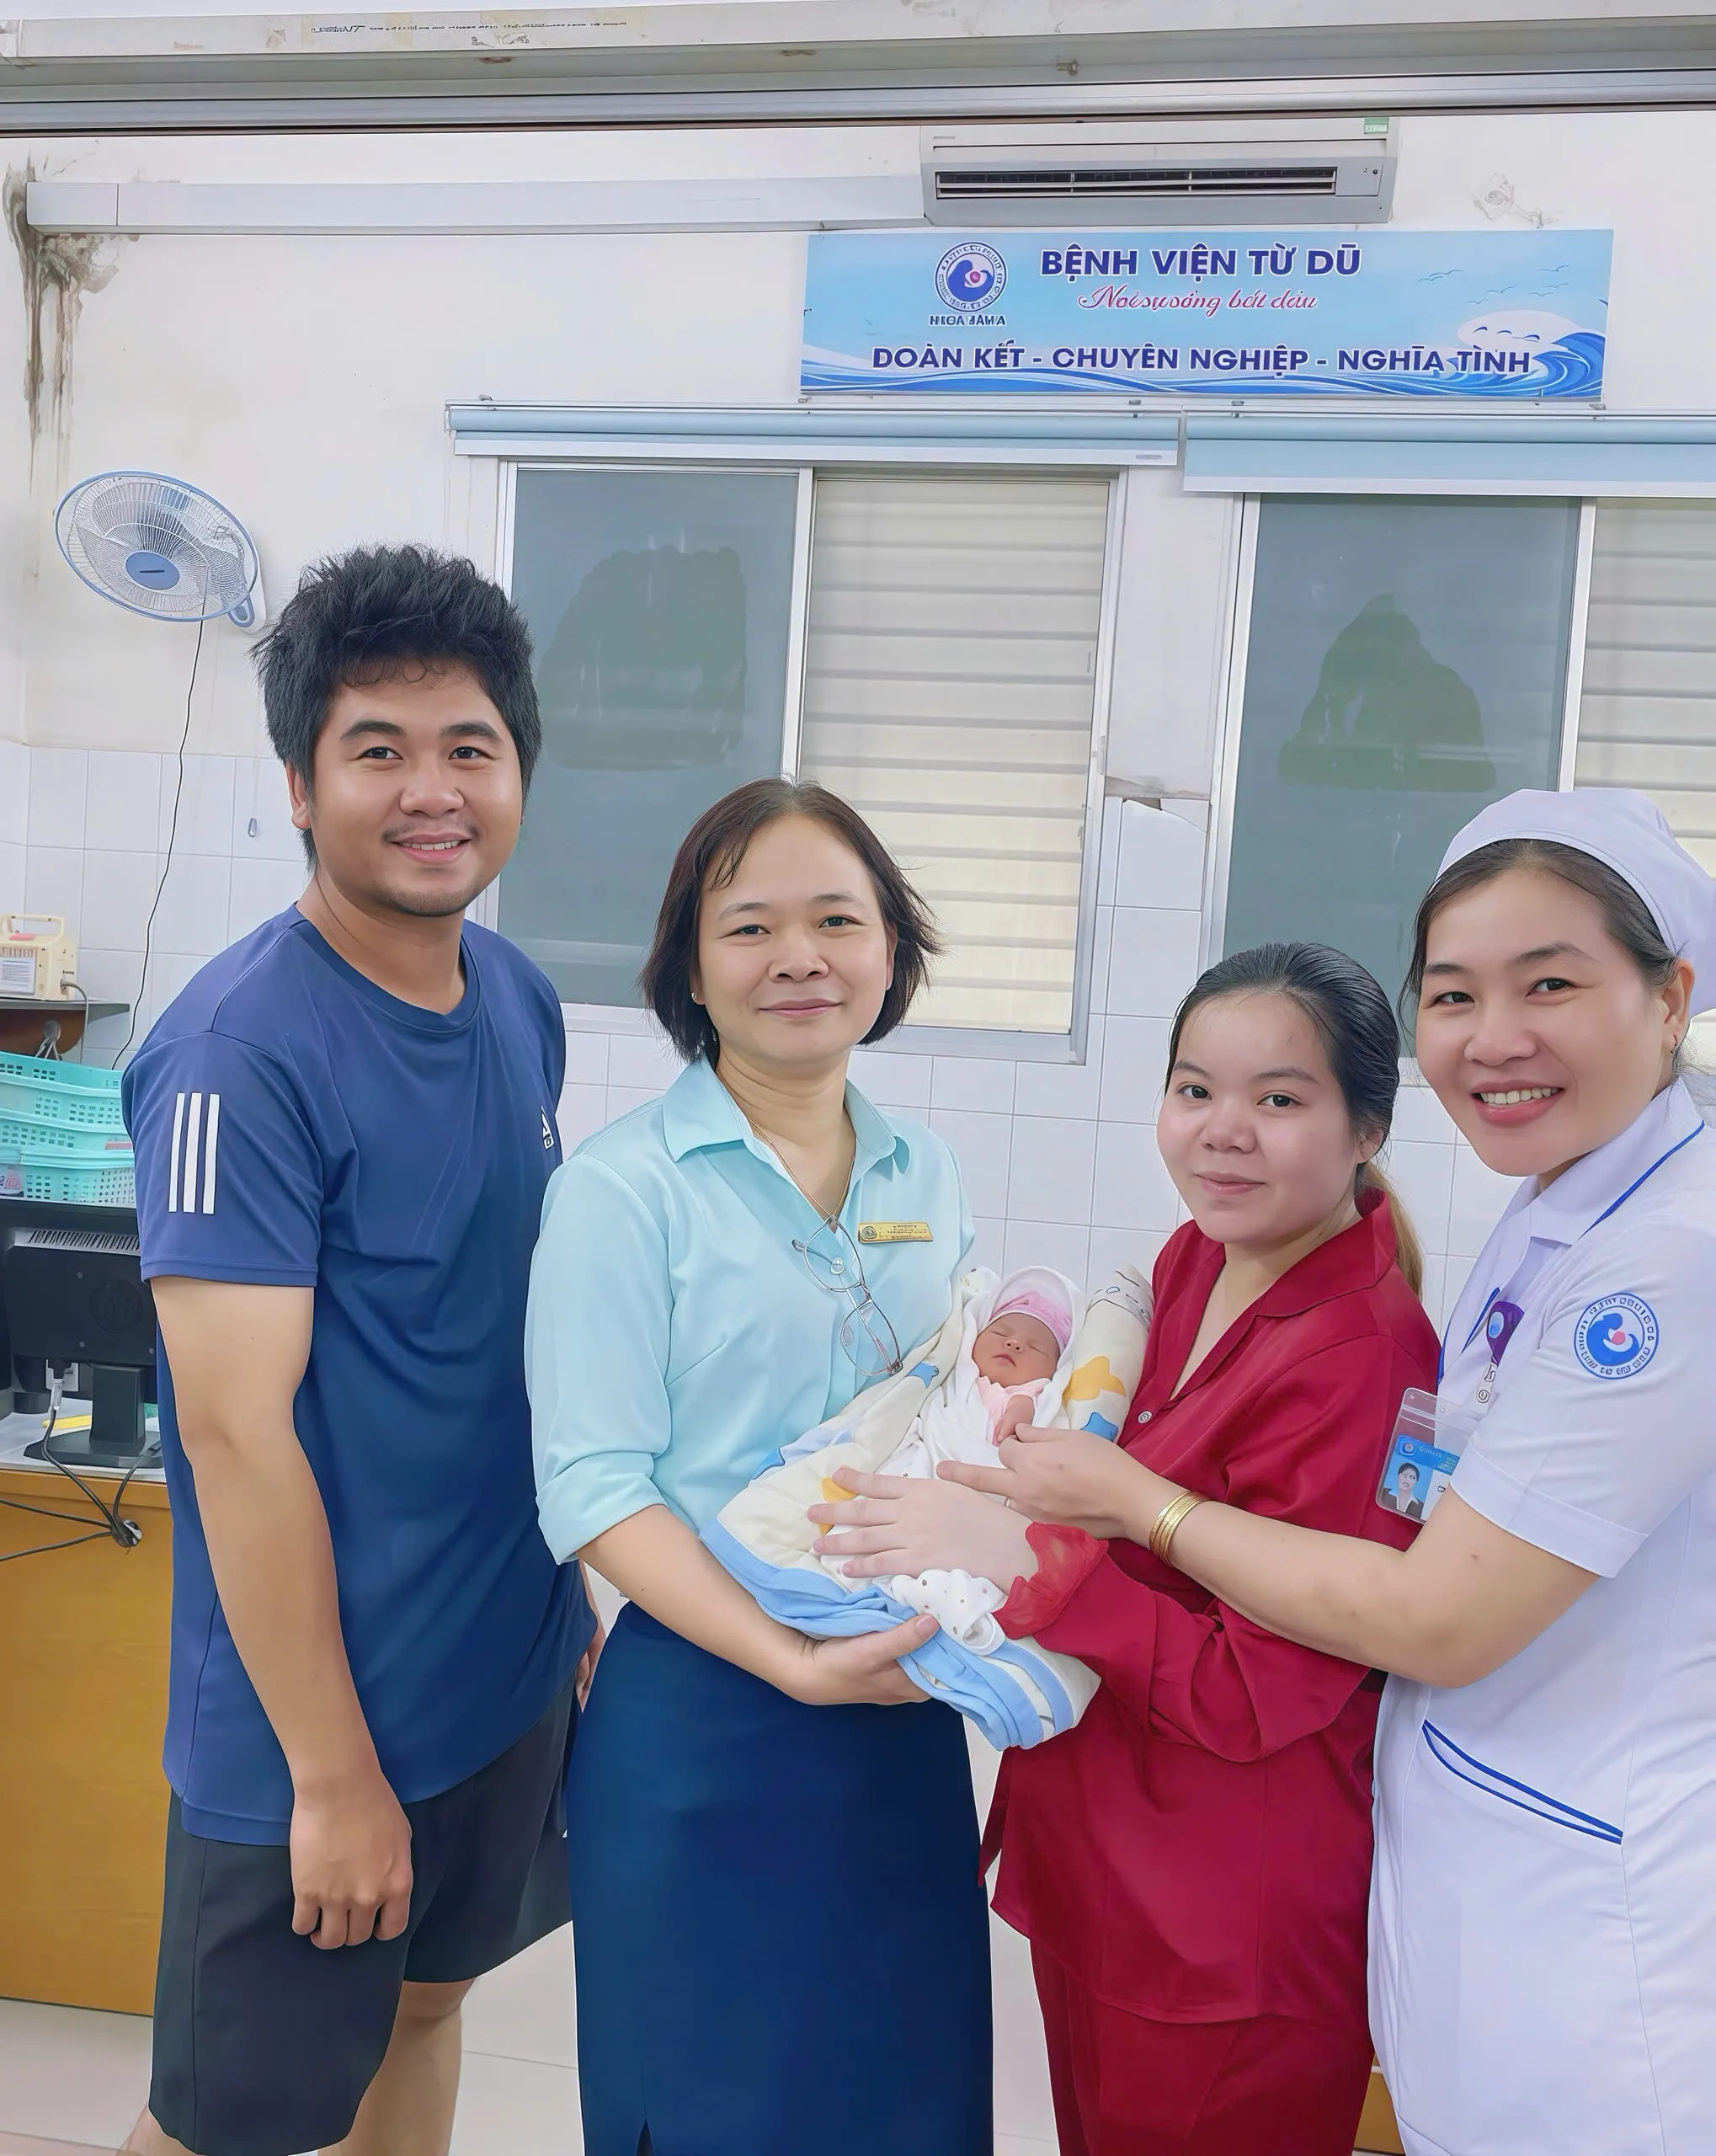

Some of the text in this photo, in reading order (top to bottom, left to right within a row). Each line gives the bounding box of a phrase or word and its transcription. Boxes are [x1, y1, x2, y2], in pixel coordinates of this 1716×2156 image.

[1041, 243, 1138, 282] BỆNH
[1150, 243, 1236, 282] VIỆN
[1248, 242, 1298, 276] TỪ
[974, 339, 1026, 369] KẾT
[1052, 342, 1179, 370] CHUYÊN
[1189, 344, 1309, 377] NGHIỆP
[1457, 344, 1531, 373] TÌNH
